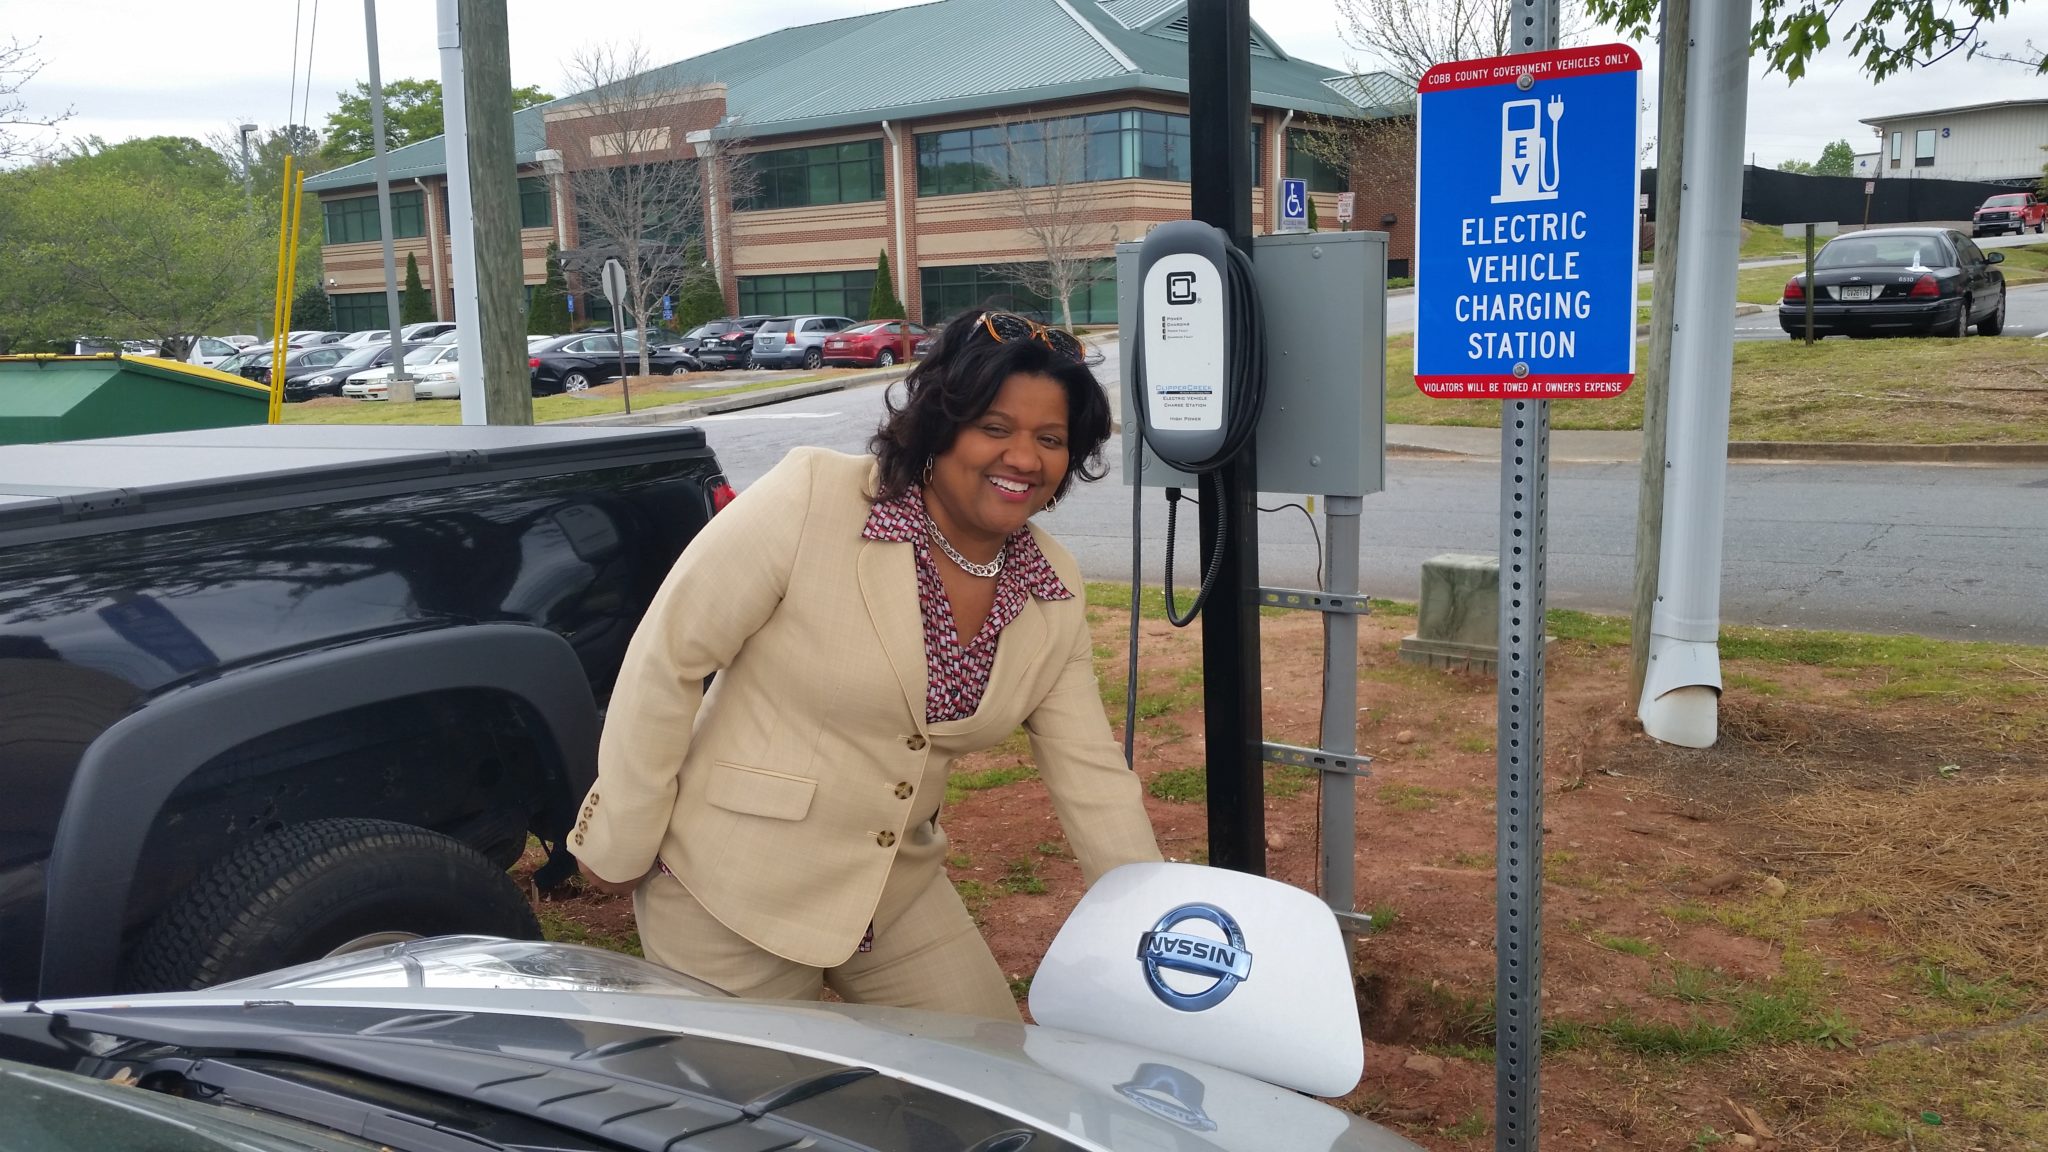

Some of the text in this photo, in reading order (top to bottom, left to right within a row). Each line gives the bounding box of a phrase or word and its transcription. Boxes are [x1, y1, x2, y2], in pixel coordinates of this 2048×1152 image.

[1428, 53, 1630, 85] COBB COUNTY GOVERNMENT VEHICLES ONLY
[1941, 127, 1950, 138] 3
[1461, 210, 1588, 246] ELECTRIC
[1467, 251, 1580, 284] VEHICLE
[1455, 290, 1591, 323] CHARGING
[1467, 330, 1576, 360] STATION
[1423, 382, 1622, 393] VIOLATORS WILL BE TOWED AT OWNER'S EXPENSE
[1147, 936, 1236, 968] NISSAN
